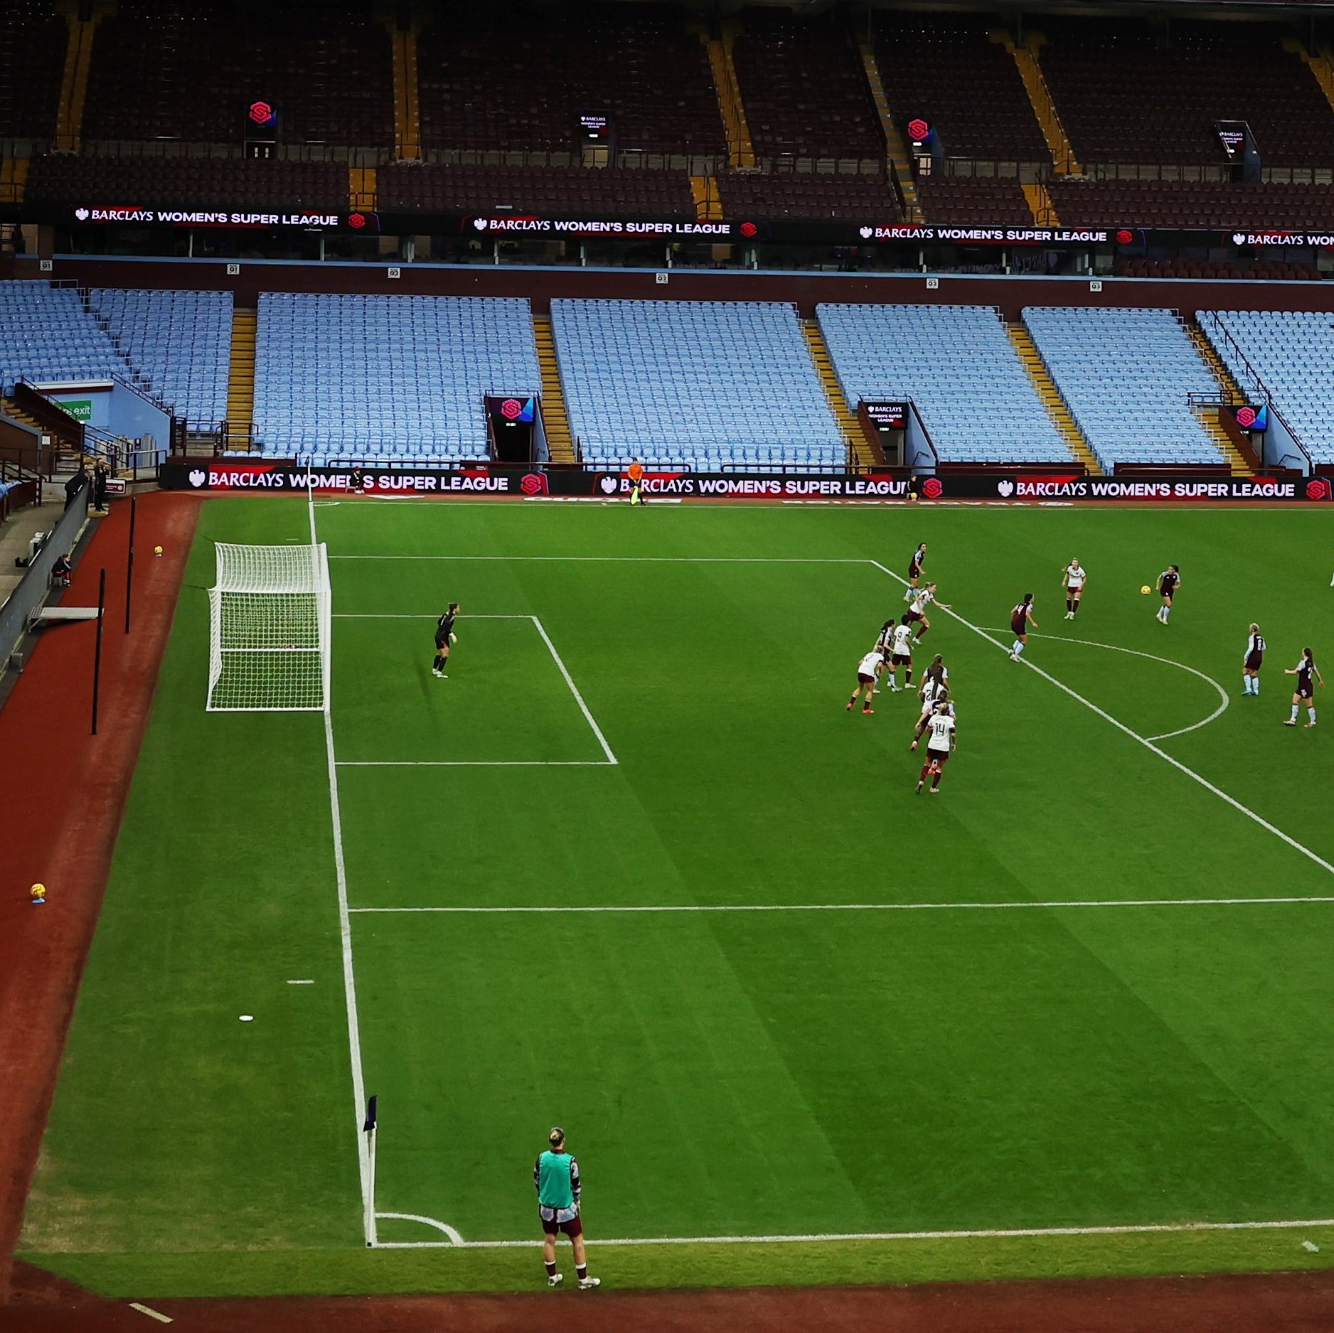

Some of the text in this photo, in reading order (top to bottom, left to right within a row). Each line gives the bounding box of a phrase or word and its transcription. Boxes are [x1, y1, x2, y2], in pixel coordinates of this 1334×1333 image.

[91, 209, 339, 226] BARCLAYS WOMEN'S SUPER LEAGUE
[489, 219, 731, 235] BARCLAYS WOMEN'S SUPER LEAGUE
[874, 227, 1107, 242] BARCLAYS WOMEN'S SUPER LEAGUE
[1247, 234, 1304, 246] BARCLAYS
[73, 405, 91, 415] exit
[208, 472, 509, 491] BARCLAYS WOMES SUPER LEAGUE
[619, 478, 694, 494] BRCLAYS
[698, 479, 782, 495] WOMEN'S
[785, 479, 842, 495] SUPER
[1016, 482, 1295, 497] BARCLAYS WOMEN'S SUPER LEAGUE
[934, 722, 946, 737] 14
